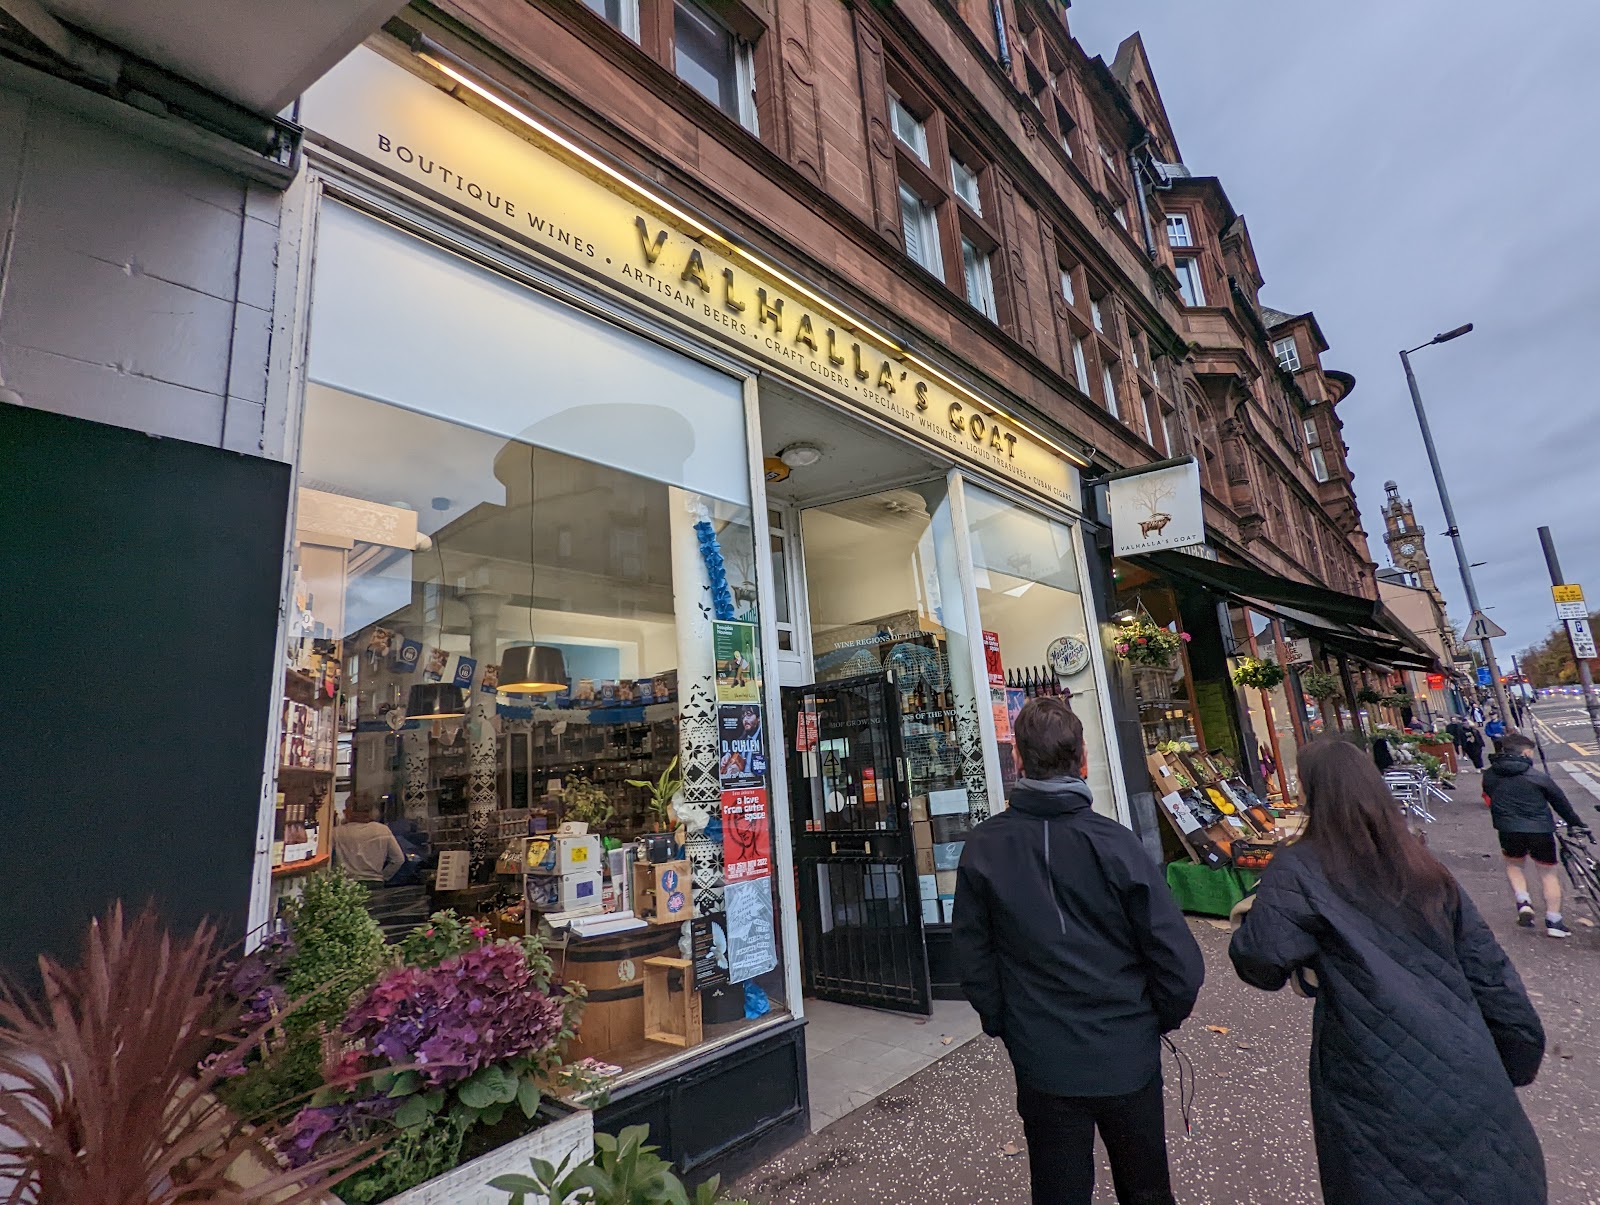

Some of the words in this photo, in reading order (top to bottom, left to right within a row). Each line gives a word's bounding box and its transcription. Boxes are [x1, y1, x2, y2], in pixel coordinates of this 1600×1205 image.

[378, 133, 516, 218] BOUTIQUE
[527, 212, 595, 258] WINES
[622, 262, 696, 309] ARTISAN
[703, 304, 747, 336] BEERS
[765, 337, 805, 366] CRAFT
[810, 360, 850, 389] CIDERS
[863, 387, 916, 422] SPECIALIST
[918, 415, 957, 443] WHISKIES
[965, 441, 990, 461] LIQUID
[992, 454, 1027, 480] TREASURES
[1033, 476, 1052, 493] CUBAN
[635, 215, 929, 412] VALHALLA'S
[949, 401, 1018, 460] GOAT
[1120, 538, 1170, 552] VALHALLA'S
[1173, 534, 1198, 543] GOAT
[834, 641, 855, 649] WINE
[856, 635, 890, 647] REGIONS
[891, 633, 902, 641] OF
[904, 630, 920, 639] THE
[915, 712, 926, 720] OF
[928, 710, 943, 718] THE
[722, 739, 731, 753] D.
[731, 739, 760, 753] CULLEN
[737, 797, 742, 805] a
[743, 795, 760, 804] love
[723, 805, 743, 815] from
[744, 803, 765, 812] outer
[744, 811, 766, 822] space
